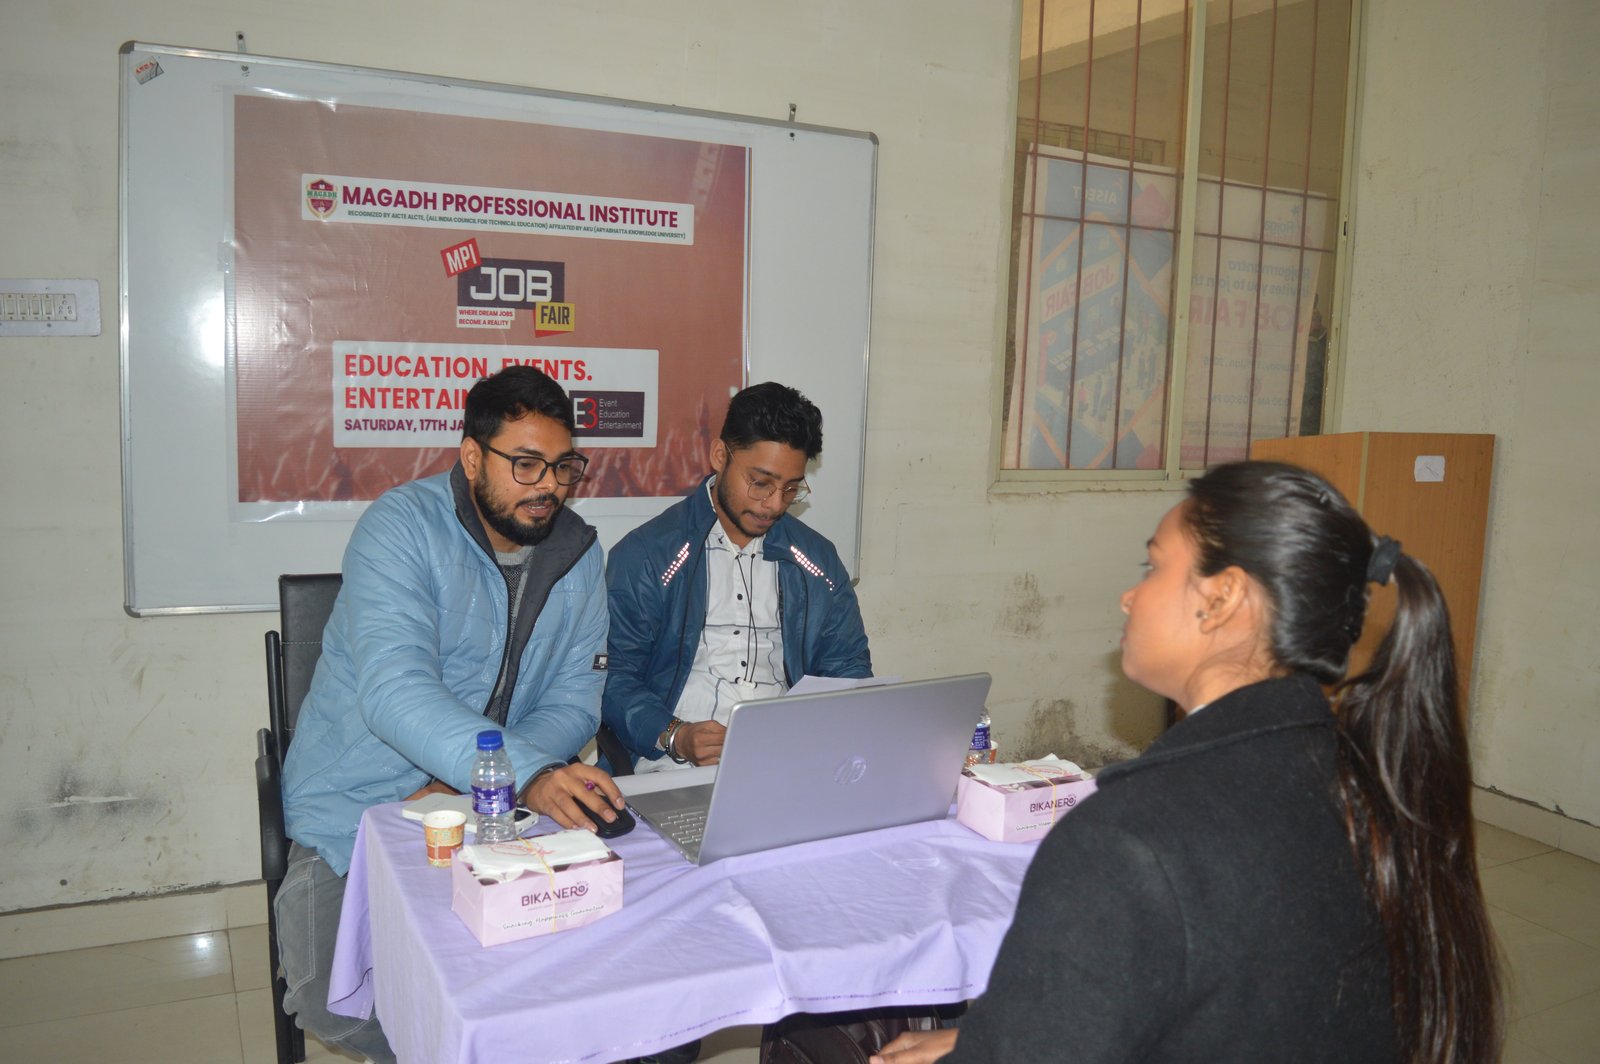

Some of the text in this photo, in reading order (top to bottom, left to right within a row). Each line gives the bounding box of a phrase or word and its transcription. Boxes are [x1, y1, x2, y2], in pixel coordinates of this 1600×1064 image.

[307, 190, 338, 198] MAGADH
[342, 185, 678, 228] MAGADH PROFESSIONAL INSTITUTE
[348, 210, 383, 218] RECOGNIZED
[426, 214, 438, 222] (ALL
[488, 219, 516, 227] TECHNICAL
[517, 221, 549, 230] EDUCATION)
[594, 226, 628, 235] (ARYABHATTA
[628, 229, 657, 237] KNOWLEDGE
[657, 231, 686, 240] UNIVERSITY)
[445, 243, 478, 274] MPI
[470, 266, 553, 303] JOB
[540, 305, 570, 325] FAIR
[573, 397, 599, 429] E3
[599, 399, 618, 407] Event
[599, 410, 631, 419] Education
[344, 419, 417, 433] SATURDAY,
[419, 419, 447, 432] 17TH
[599, 421, 642, 430] Entertainment
